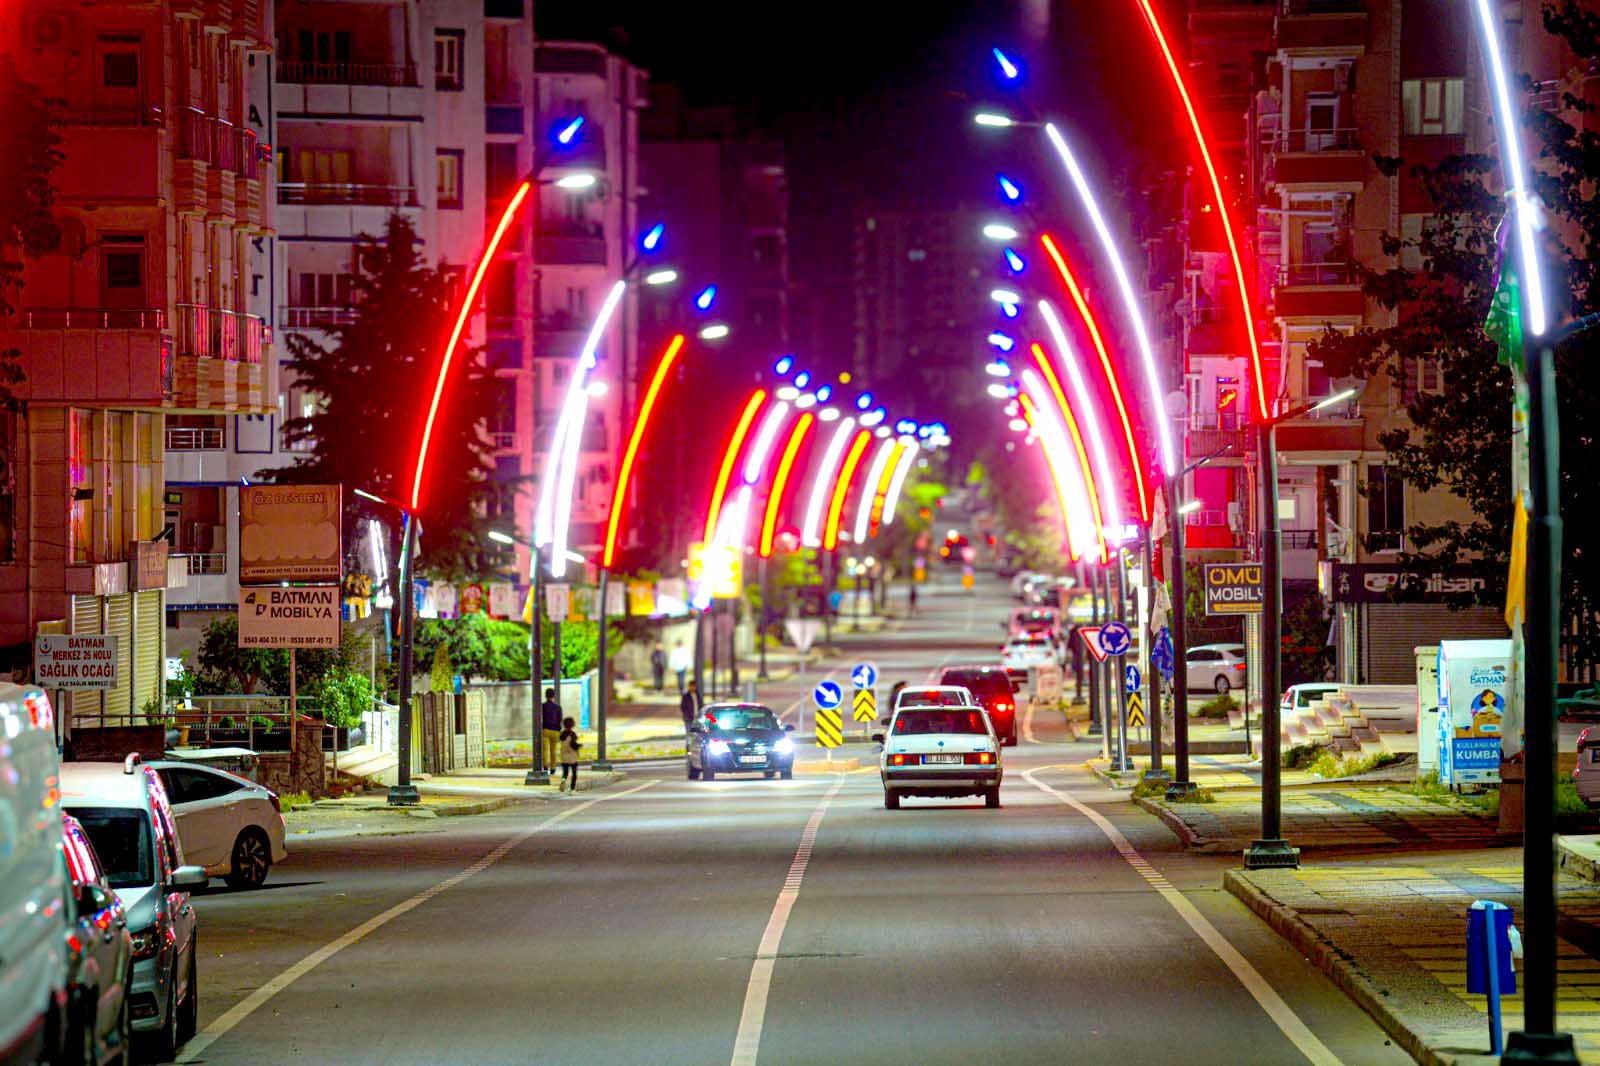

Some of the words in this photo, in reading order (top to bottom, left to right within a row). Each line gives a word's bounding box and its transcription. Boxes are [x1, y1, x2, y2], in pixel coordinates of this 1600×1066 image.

[271, 591, 332, 604] BATMAN
[68, 638, 105, 649] BATMAN
[52, 650, 81, 661] MERKEZ
[93, 650, 112, 660] NOLU
[40, 661, 79, 678] SAĞLIK
[81, 662, 115, 678] OCAĞI
[1470, 674, 1506, 684] BATMAN
